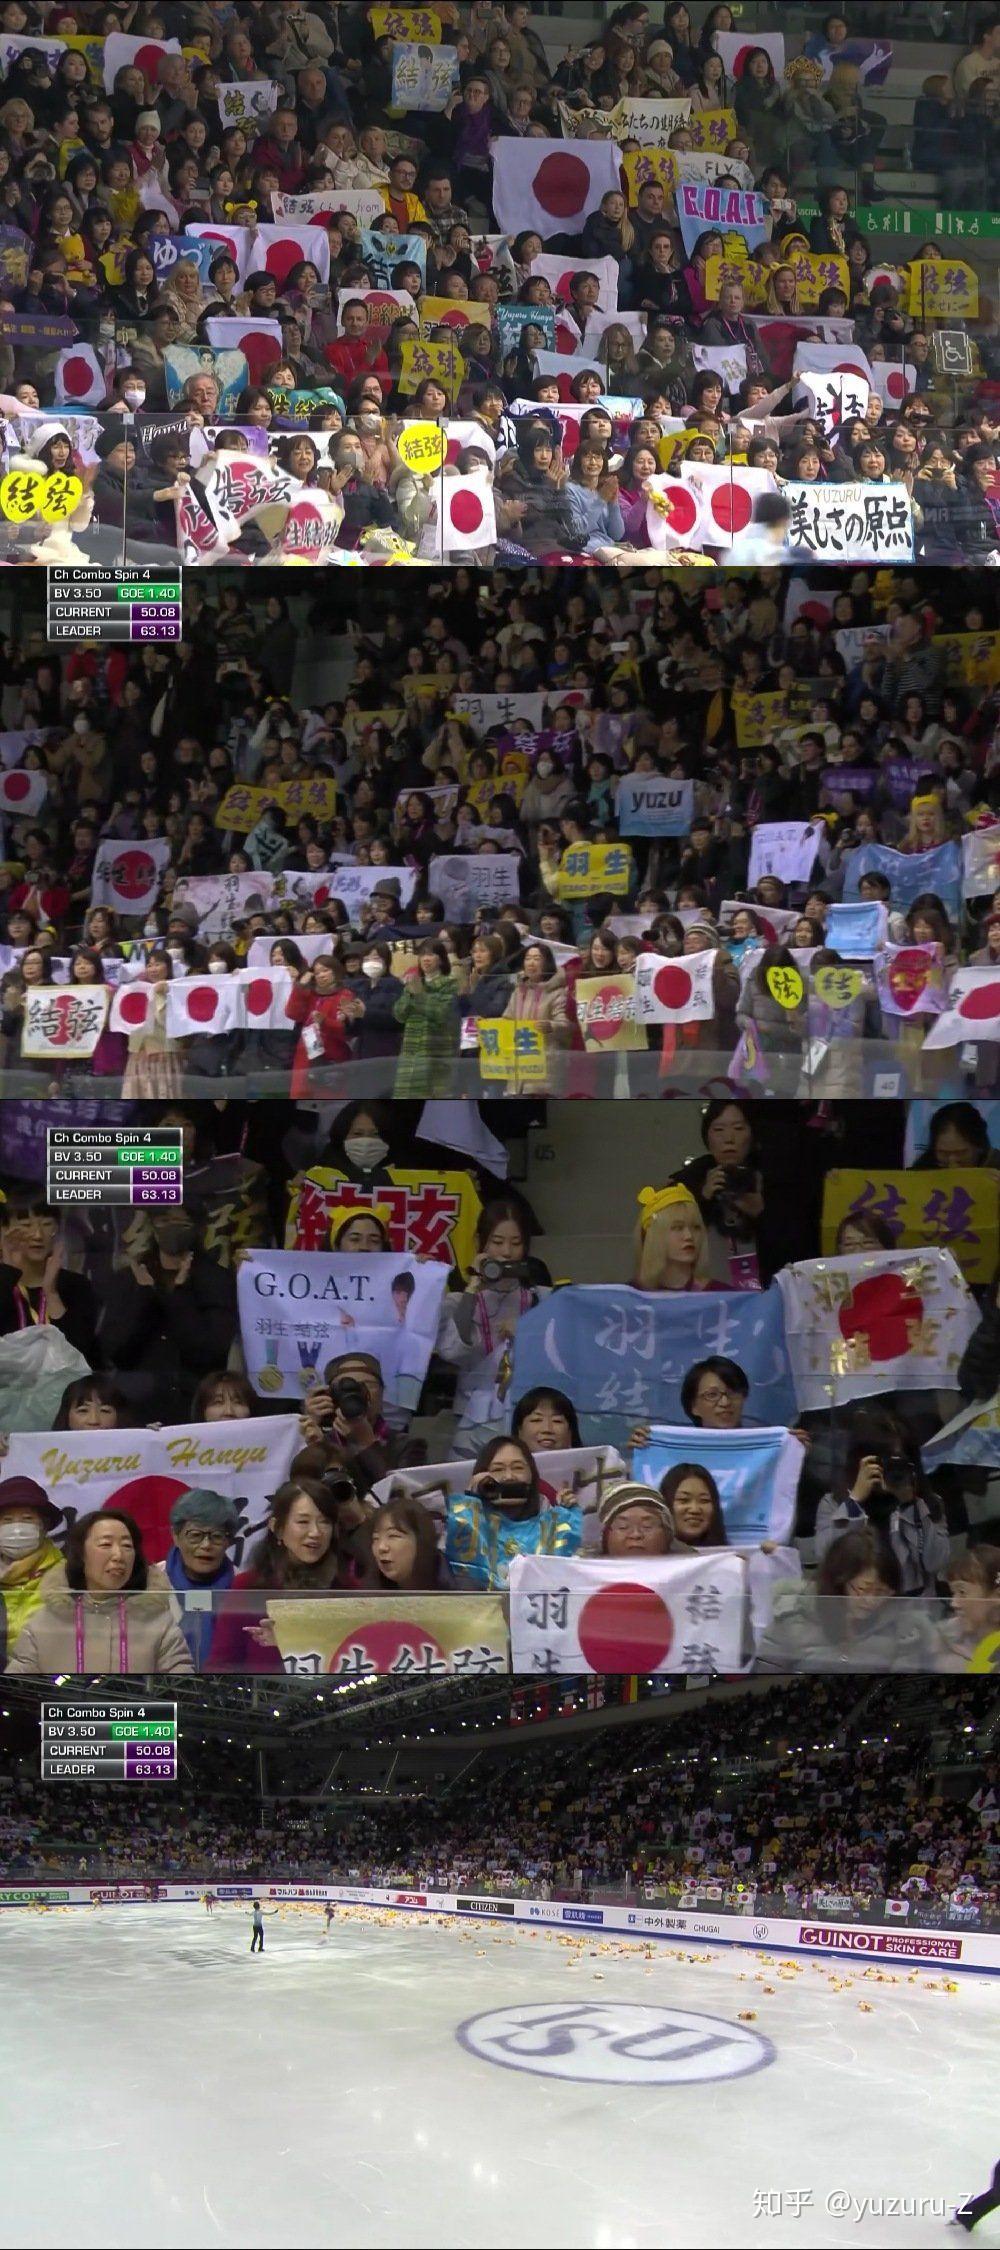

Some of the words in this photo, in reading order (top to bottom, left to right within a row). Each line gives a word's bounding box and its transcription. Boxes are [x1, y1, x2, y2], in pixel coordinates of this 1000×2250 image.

[705, 160, 734, 177] FLY
[404, 437, 442, 462] 結弦
[7, 477, 75, 516] 結弦
[812, 488, 862, 504] YUZURU
[790, 490, 912, 552] 美しさの原点
[28, 998, 103, 1041] 結弦
[254, 1272, 375, 1302] G.O.A.T.
[40, 1448, 142, 1486] Yuzuru
[166, 1438, 268, 1473] Hanyu
[470, 1902, 498, 1912] CITIZEN
[693, 1923, 720, 1934] CHUGAI
[801, 1928, 884, 1951] GUINOT
[885, 1943, 916, 1953] SKIN
[919, 1946, 957, 1958] CARE
[886, 1936, 957, 1949] PROFESSIONAL
